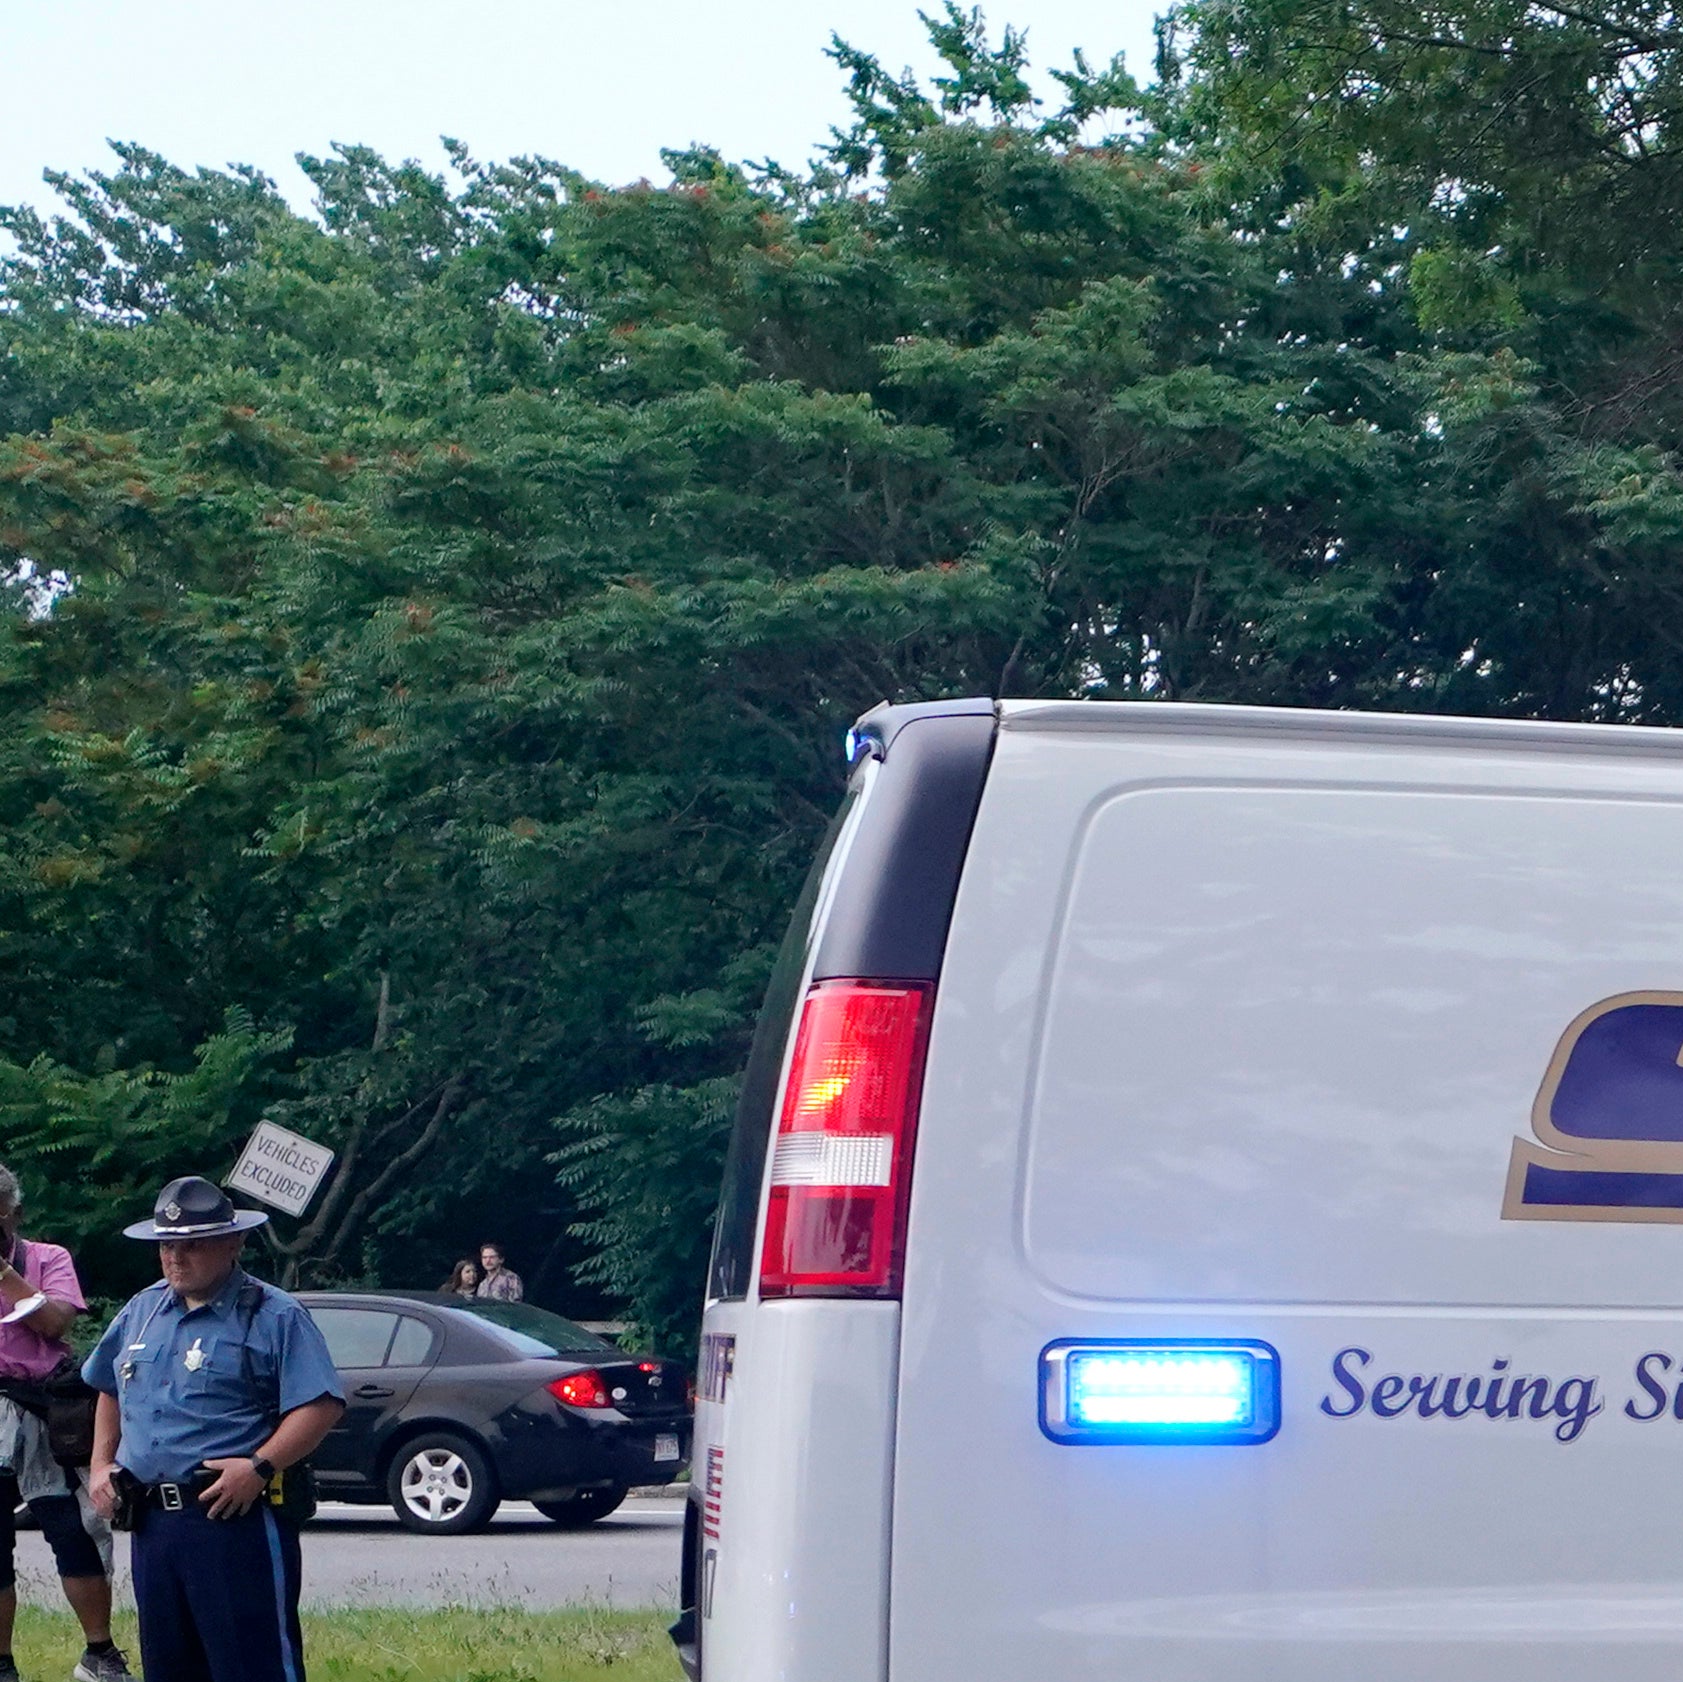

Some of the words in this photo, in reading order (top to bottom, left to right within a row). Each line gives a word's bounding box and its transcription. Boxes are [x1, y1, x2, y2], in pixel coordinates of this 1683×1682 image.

[257, 1135, 320, 1176] VEHICLES
[240, 1160, 307, 1201] EXCLUDED
[1320, 1346, 1604, 1445] Serving
